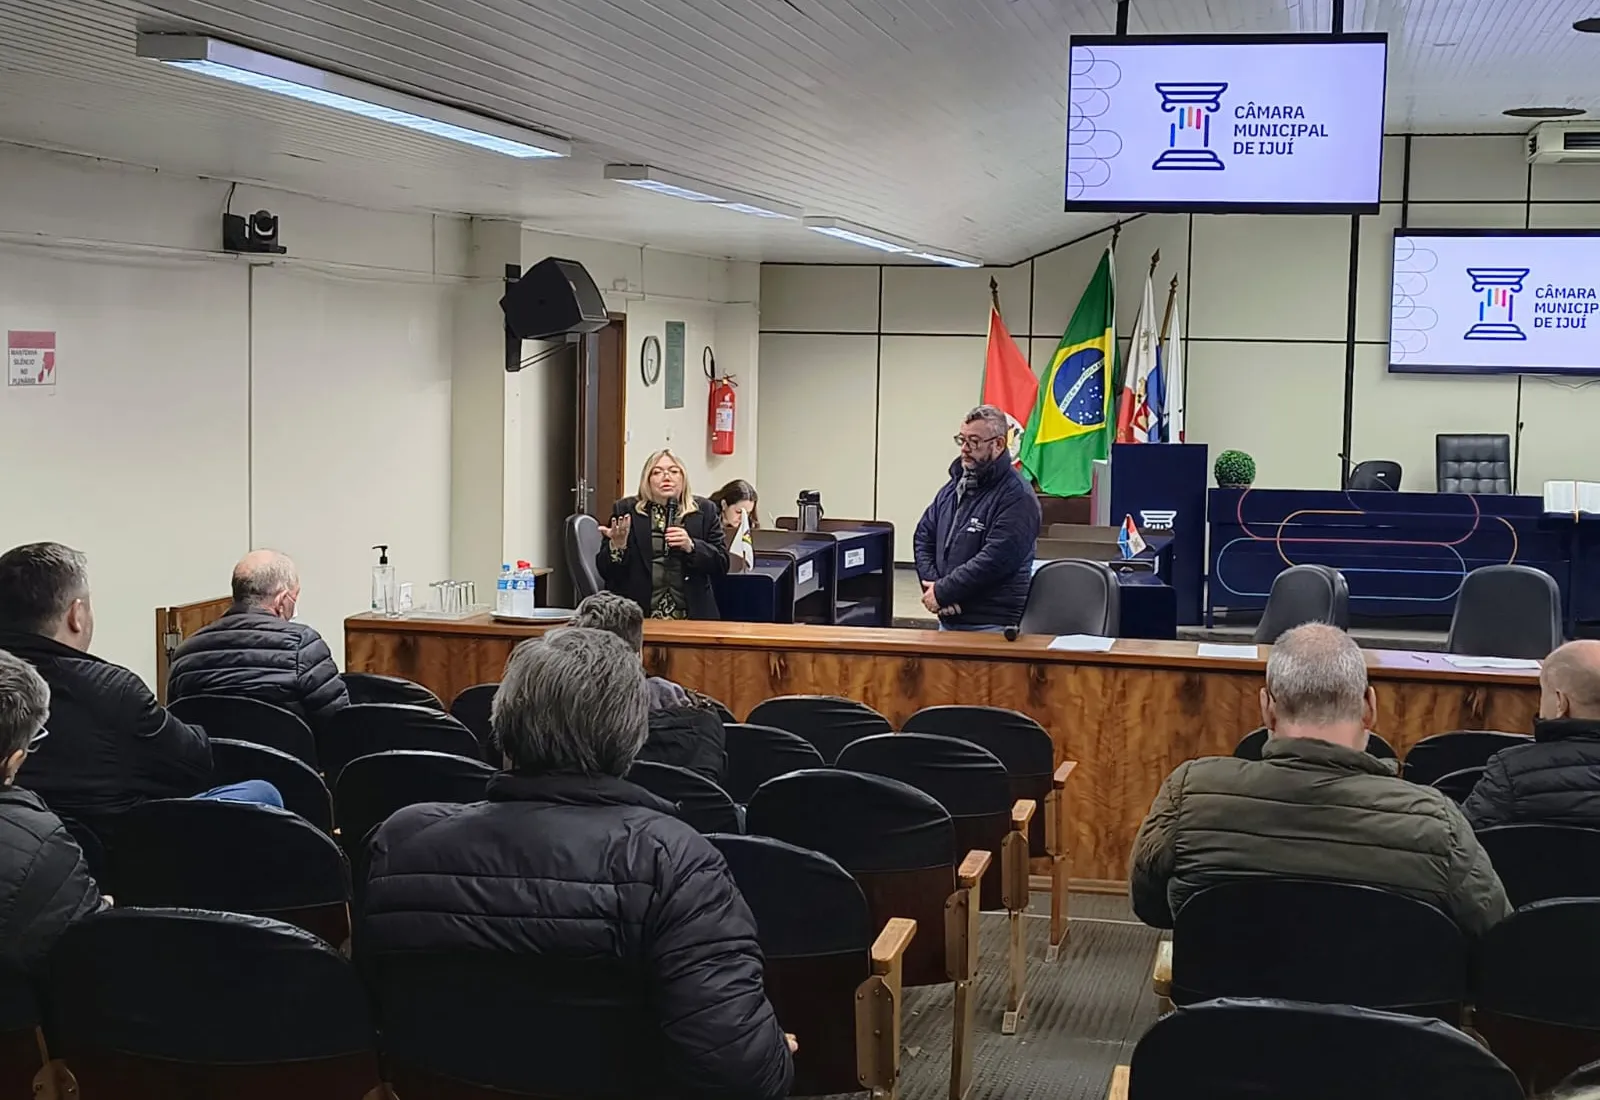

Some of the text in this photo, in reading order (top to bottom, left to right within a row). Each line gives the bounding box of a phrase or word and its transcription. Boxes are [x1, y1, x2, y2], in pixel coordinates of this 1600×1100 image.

[1234, 102, 1305, 119] CÂMARA
[1233, 123, 1329, 138] MUNICIPAL
[1233, 138, 1294, 155] DE IJUÍ
[1535, 284, 1597, 299] CÂMARA
[1534, 314, 1586, 329] DE IJUÍ
